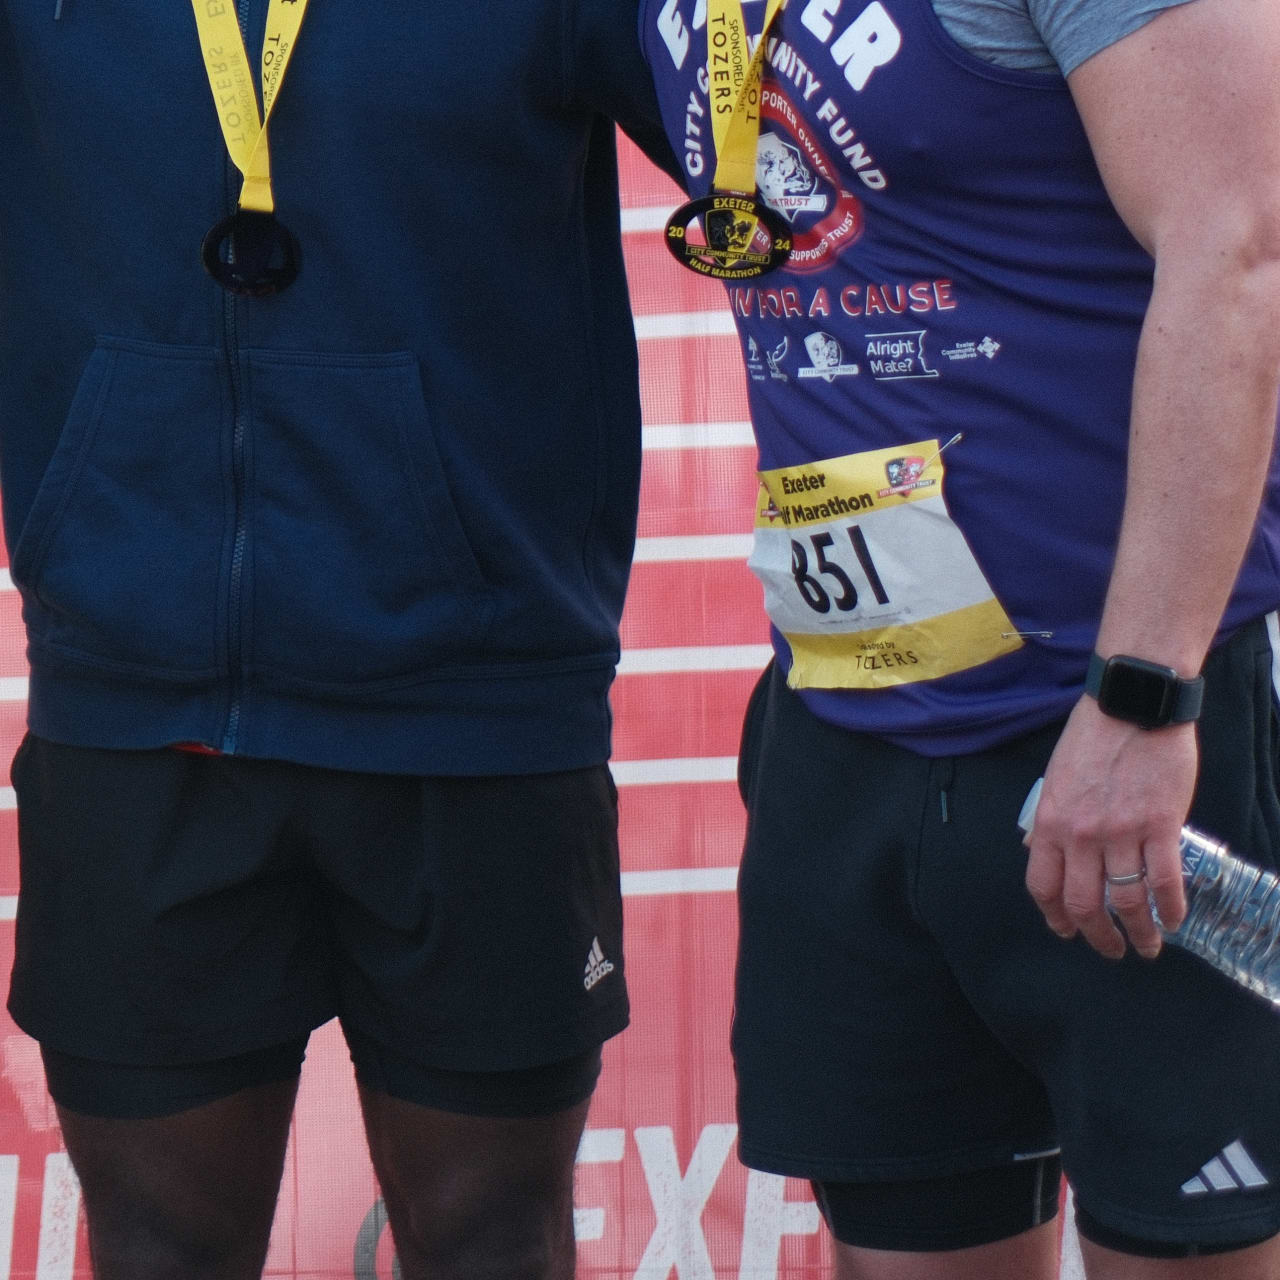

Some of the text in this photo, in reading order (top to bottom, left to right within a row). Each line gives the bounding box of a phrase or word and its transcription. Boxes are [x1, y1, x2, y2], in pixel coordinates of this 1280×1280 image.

[712, 12, 733, 114] TOZERS
[685, 91, 704, 177] CITY
[816, 98, 886, 189] FUND
[762, 90, 832, 182] PORTER OWNE
[714, 198, 755, 212] EXETER
[668, 226, 684, 238] 20
[827, 211, 854, 242] TRUST
[774, 239, 791, 250] 24
[690, 259, 761, 278] HALF MARATHON
[808, 287, 831, 317] A
[840, 279, 957, 317] CAUSE
[866, 340, 915, 358] Alright
[870, 358, 913, 374] Mate?
[781, 473, 825, 495] Exeter
[792, 493, 874, 523] Marathon
[791, 524, 890, 614] 851
[584, 960, 614, 991] adidas
